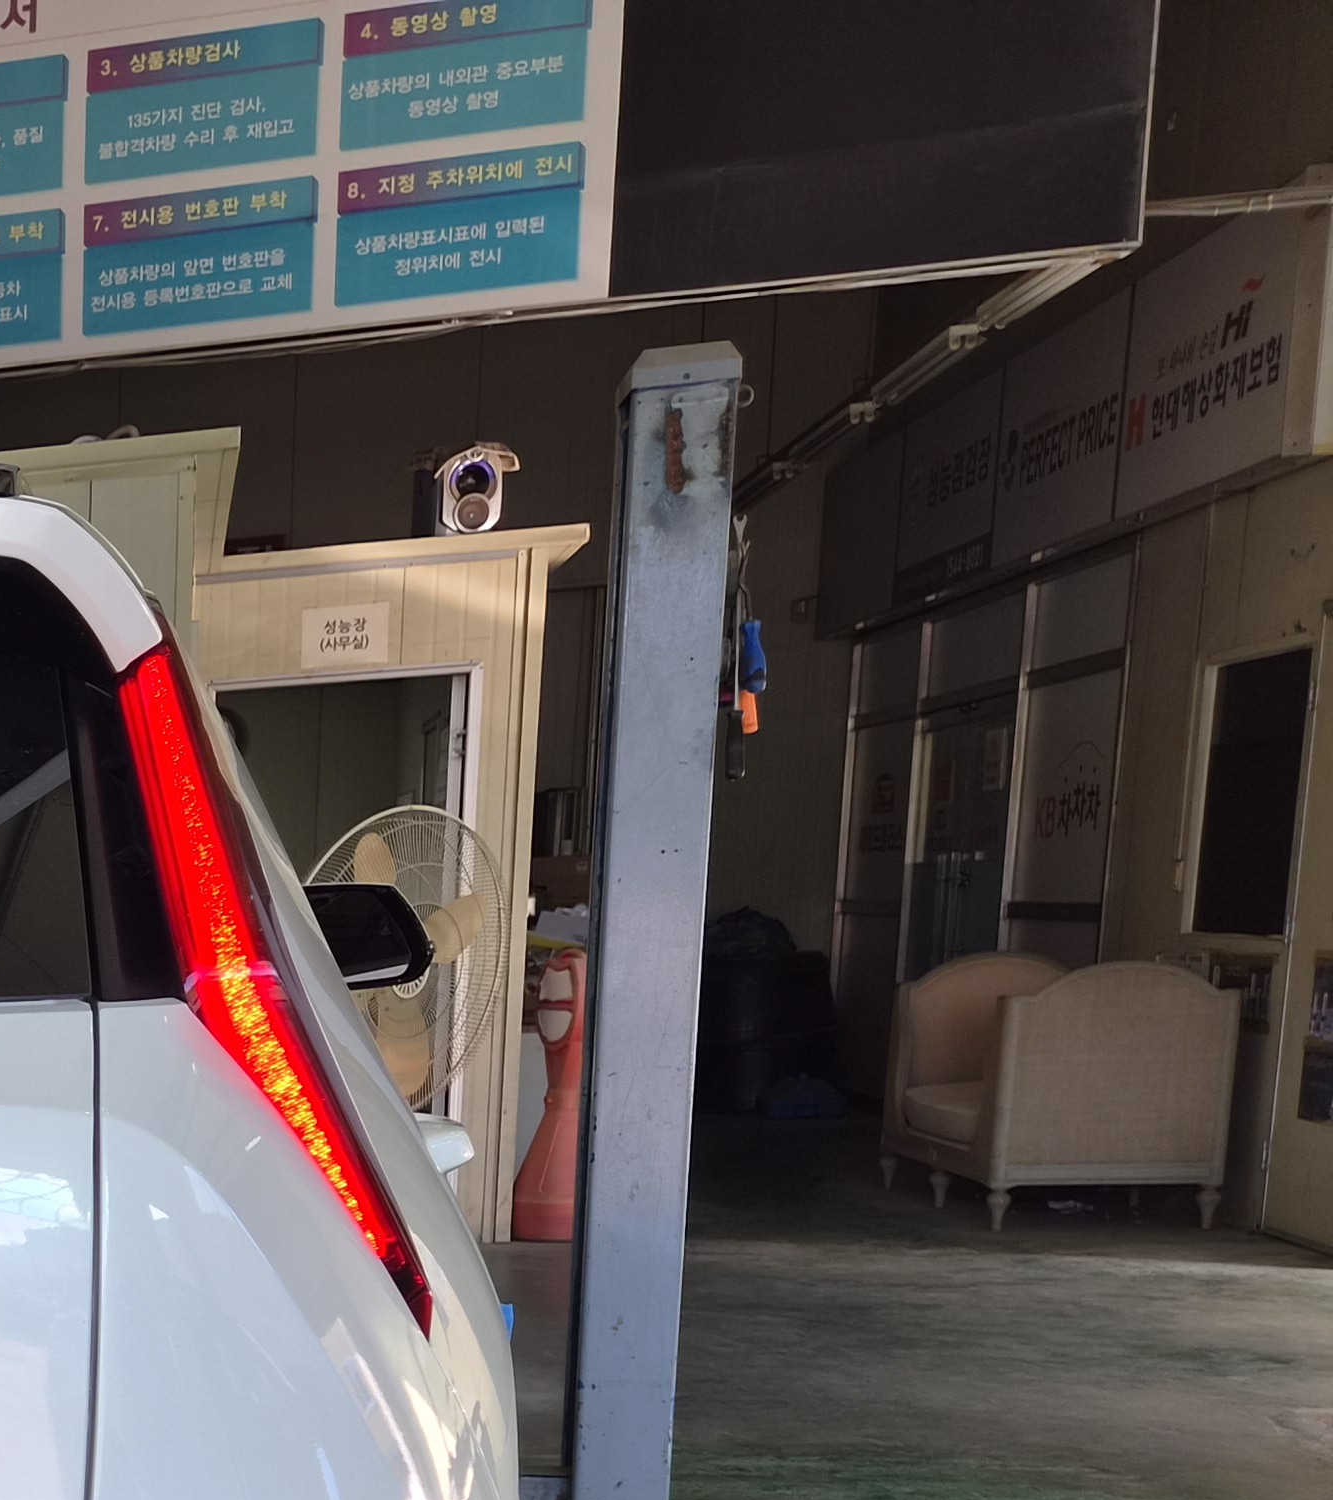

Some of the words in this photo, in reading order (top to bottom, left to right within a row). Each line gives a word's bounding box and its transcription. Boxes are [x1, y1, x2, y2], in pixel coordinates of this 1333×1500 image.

[360, 23, 379, 40] 4.
[390, 10, 449, 37] 동영상
[460, 4, 497, 27] 촬영
[100, 60, 117, 77] 3.
[130, 40, 240, 73] 상품차량검사
[348, 73, 430, 100] 상품차량의
[438, 66, 488, 87] 내외관
[495, 55, 564, 80] 중요부분
[127, 106, 182, 129] 135가지
[191, 102, 221, 121] 진단
[408, 97, 458, 118] 동영상
[466, 90, 499, 111] 촬영
[13, 126, 44, 145] 품질
[98, 135, 176, 160] 불합격차량
[184, 129, 214, 147] 수리
[223, 125, 238, 141] 후
[247, 119, 294, 139] 재입고
[347, 182, 365, 199] 8.
[378, 174, 415, 195] 지정
[426, 160, 523, 190] 주차위치에
[535, 154, 572, 176] 전시
[93, 216, 109, 232] 7.
[121, 206, 174, 229] 전시용
[185, 198, 239, 221] 번호판
[250, 191, 287, 213] 부착
[9, 221, 44, 243] 부착
[355, 223, 487, 256] 상품차량표시표에
[495, 216, 545, 238] 입력된
[99, 262, 175, 286] 상품차량의
[184, 257, 214, 276] 앞면
[222, 249, 285, 271] 번호판을
[395, 253, 461, 277] 정위치에
[469, 248, 502, 267] 전시
[91, 293, 136, 313] 전시용
[144, 279, 253, 307] 등록번호판으로
[260, 273, 293, 291] 교체
[1151, 333, 1283, 440] 현대해상화재보험
[1019, 415, 1076, 489] PERFECT
[1076, 392, 1118, 461] PRICE
[319, 634, 369, 653] (사무실)
[324, 617, 367, 634] 성능장
